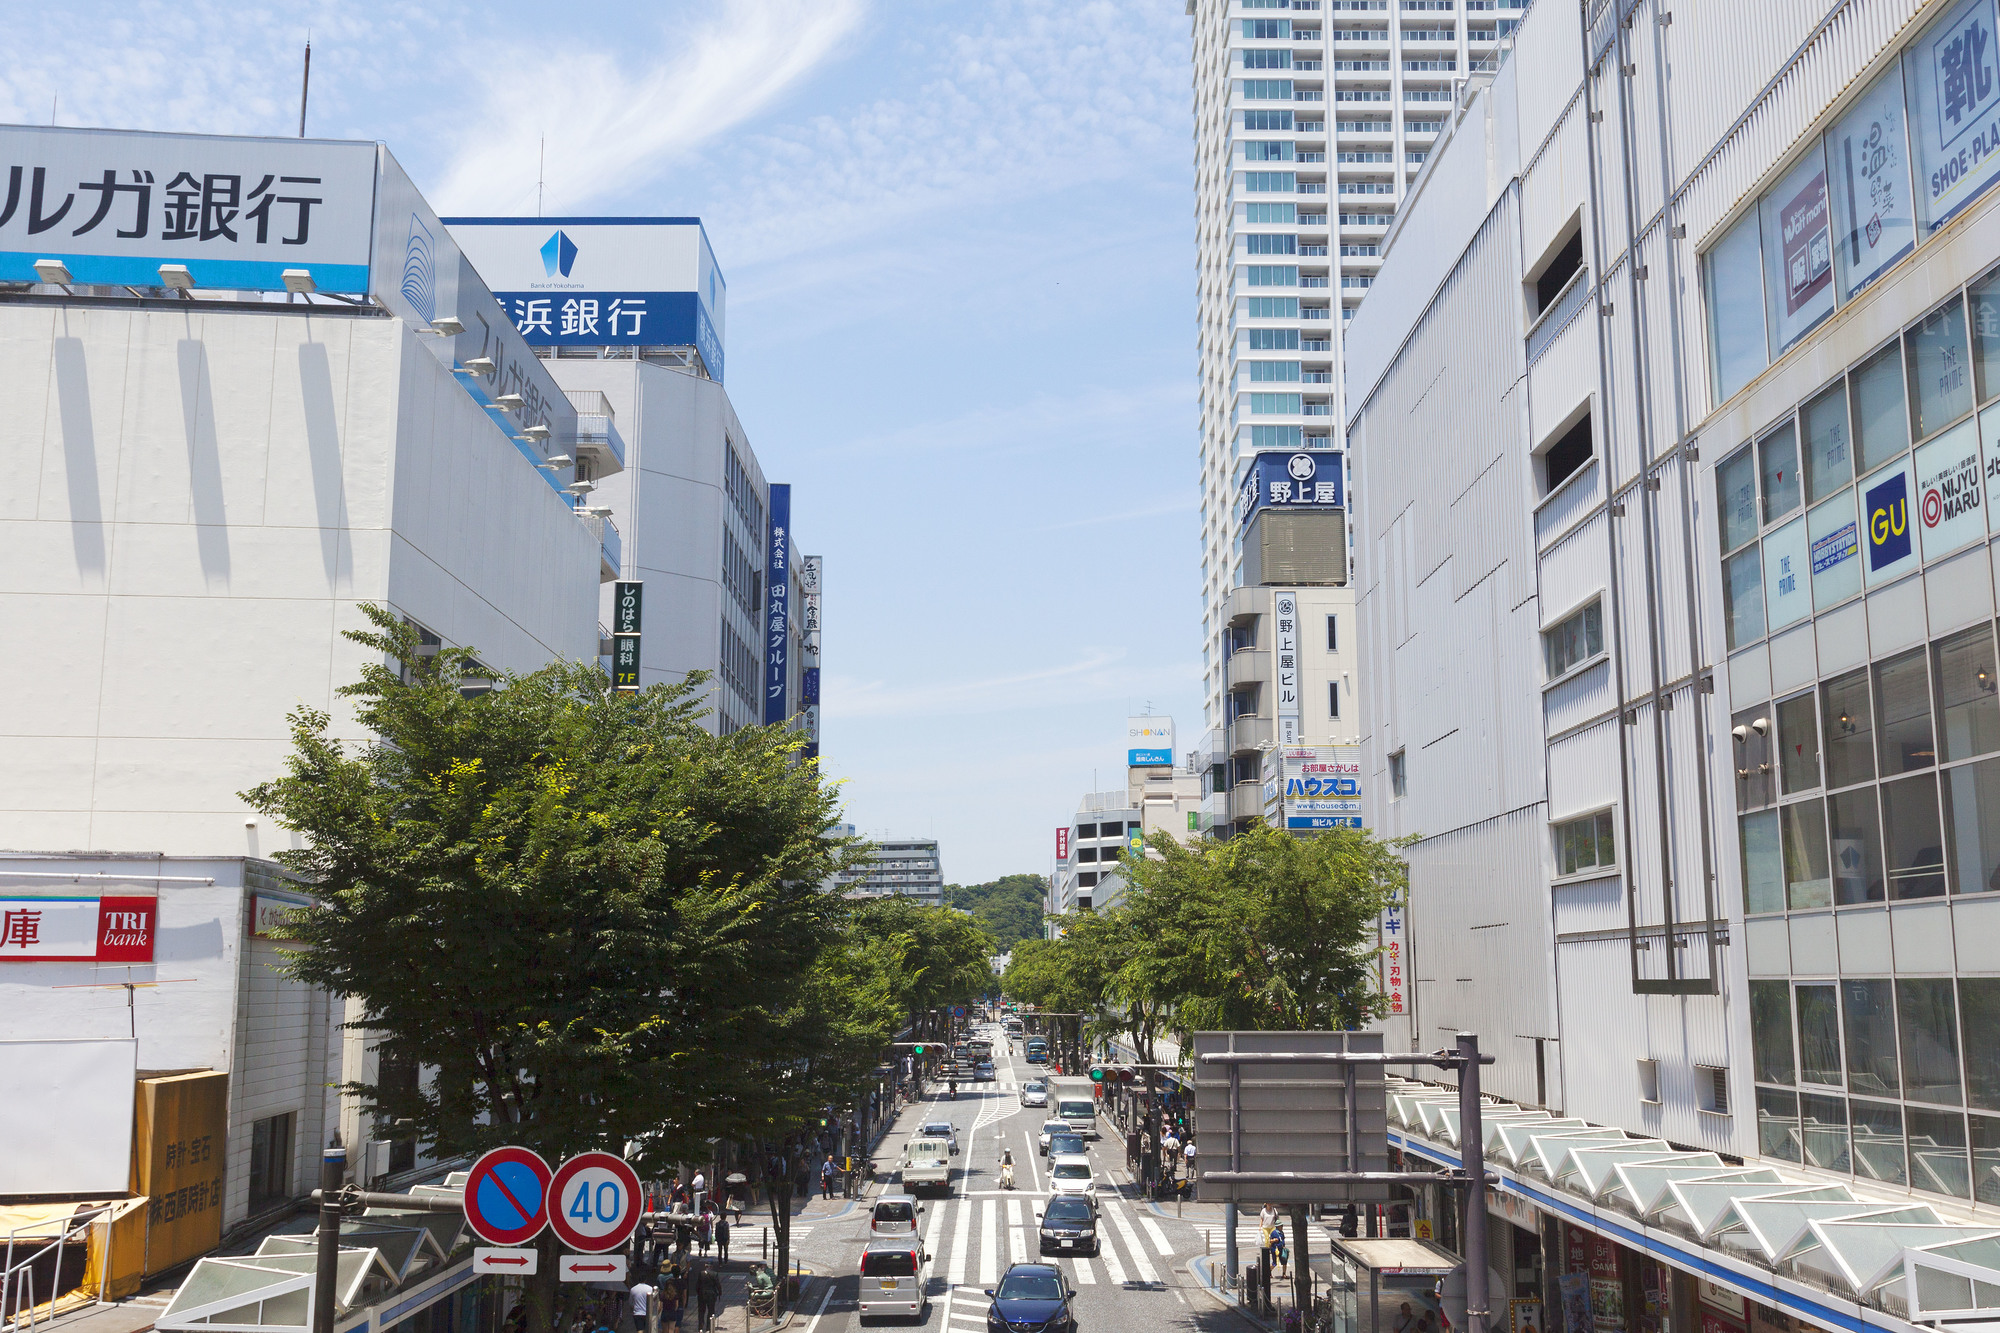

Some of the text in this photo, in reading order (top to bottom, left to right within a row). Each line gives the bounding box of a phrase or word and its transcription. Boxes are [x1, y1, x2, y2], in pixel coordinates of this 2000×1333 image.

[1941, 18, 1991, 126] 靴
[0, 166, 323, 245] ルガ銀行
[1792, 255, 1806, 289] 服
[496, 298, 647, 336] 浜銀行
[1942, 346, 1957, 371] THE
[1940, 366, 1964, 398] PRIME
[1830, 423, 1841, 446] THE
[1827, 443, 1845, 470] PRIME
[1270, 482, 1335, 504] 野上屋
[1942, 465, 1978, 501] NIJYU
[1943, 487, 1980, 522] MARU
[1870, 498, 1906, 546] GU
[774, 526, 785, 569] 株式会社
[1781, 555, 1790, 575] THE
[1779, 574, 1795, 597] PRIME
[620, 584, 635, 666] しのはら 眼科
[769, 584, 786, 698] 田丸屋グループ
[1280, 619, 1295, 703] 野上屋ビル
[618, 673, 636, 683] 7F
[1286, 777, 1361, 796] ハウスコ
[0, 908, 42, 948] 庫
[105, 911, 148, 930] TRI
[104, 930, 148, 947] bank
[569, 1181, 620, 1223] 40
[1592, 1259, 1617, 1272] GAME
[1596, 1246, 1608, 1257] BF
